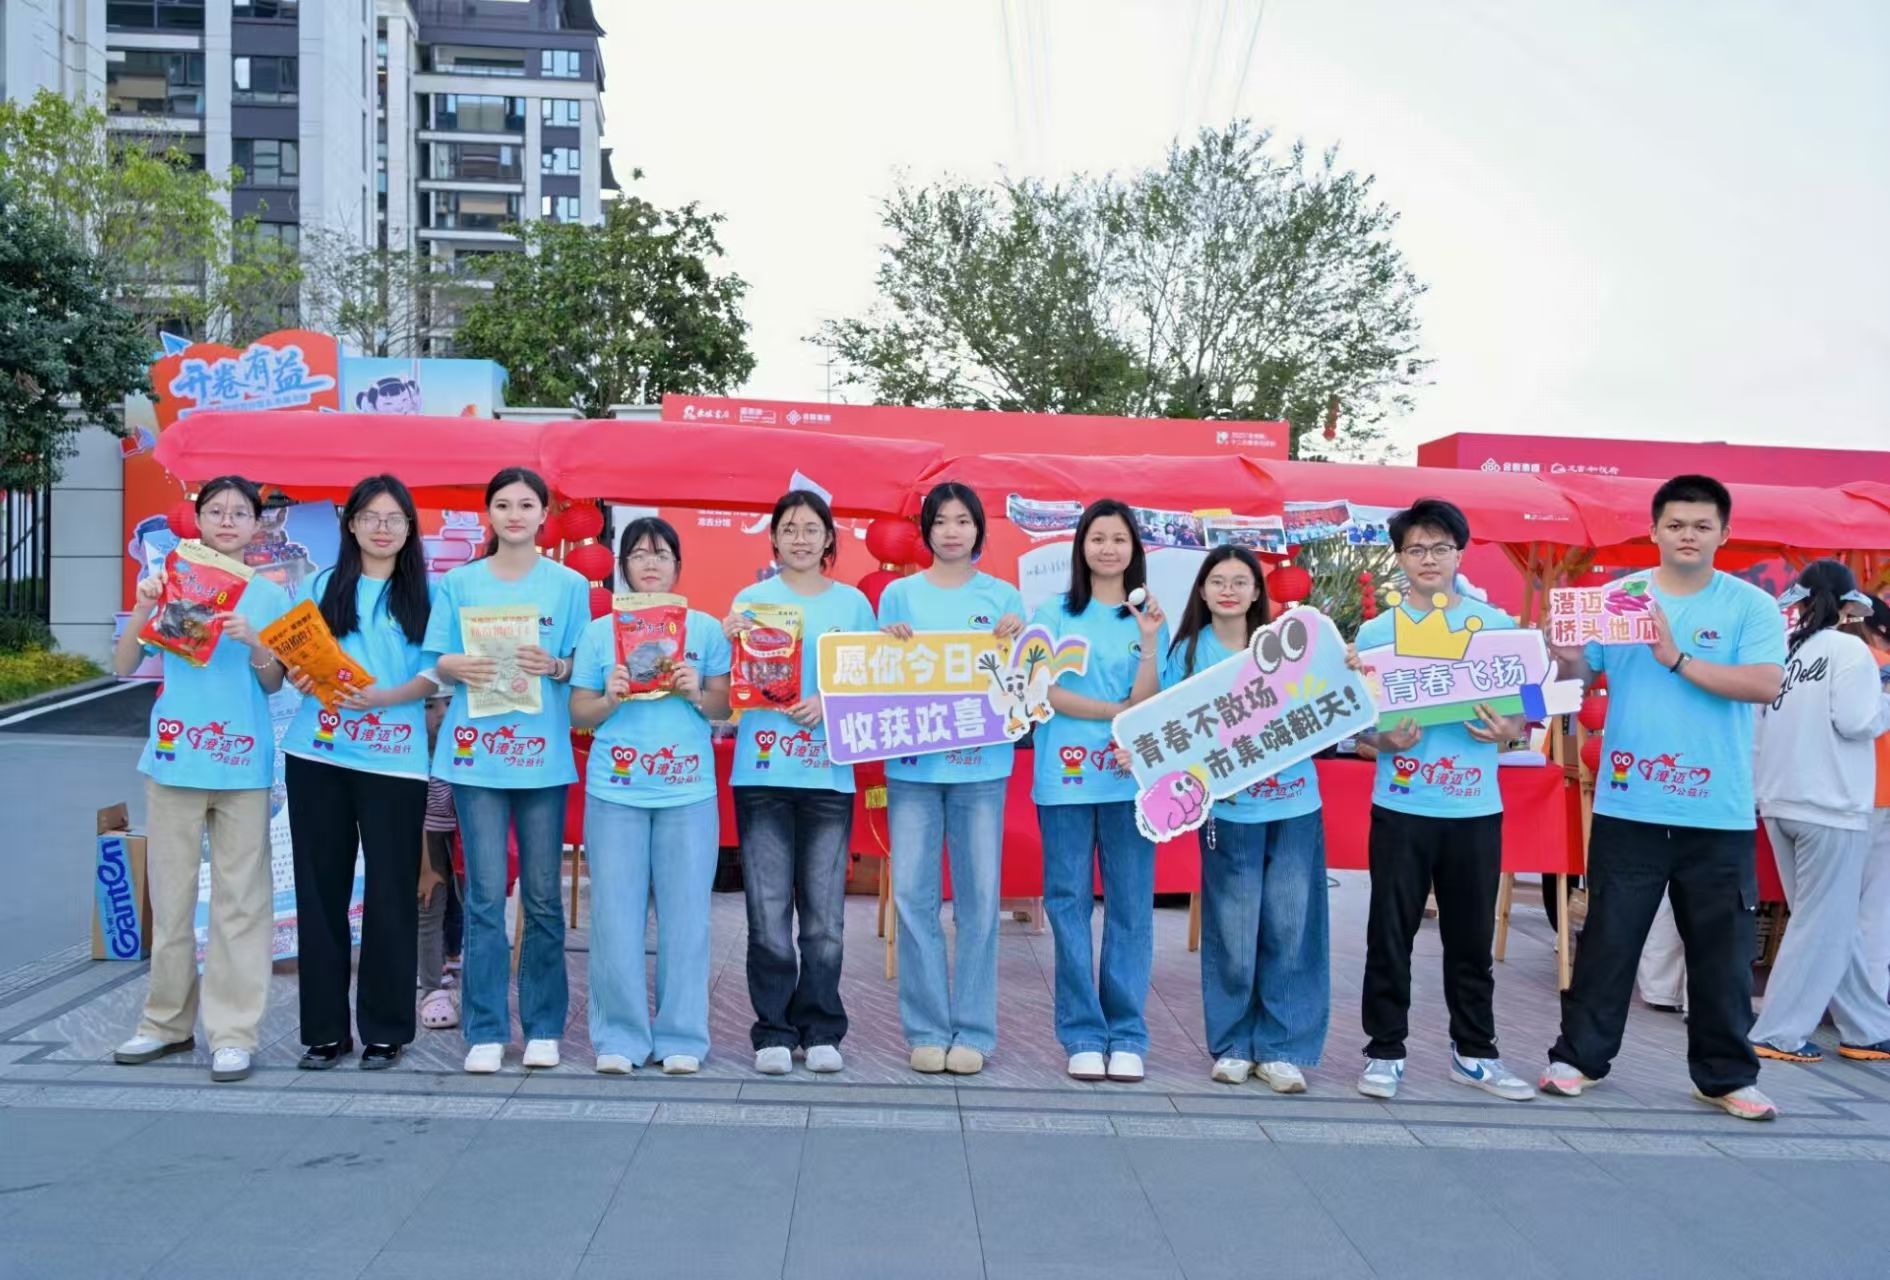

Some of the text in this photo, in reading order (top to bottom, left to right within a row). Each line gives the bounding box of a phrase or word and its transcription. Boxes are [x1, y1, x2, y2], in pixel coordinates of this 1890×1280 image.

[175, 349, 328, 402] 开卷有益
[1553, 591, 1603, 615] 澄迈
[1554, 617, 1657, 643] 桥头地瓜
[832, 643, 975, 686] 愿你今日
[1383, 655, 1527, 704] 青春飞扬
[839, 697, 987, 753] 收获欢喜
[1132, 675, 1279, 769] 青春不散场
[1204, 685, 1361, 780] 市集嗨翻天!
[96, 839, 140, 959] Ganten
